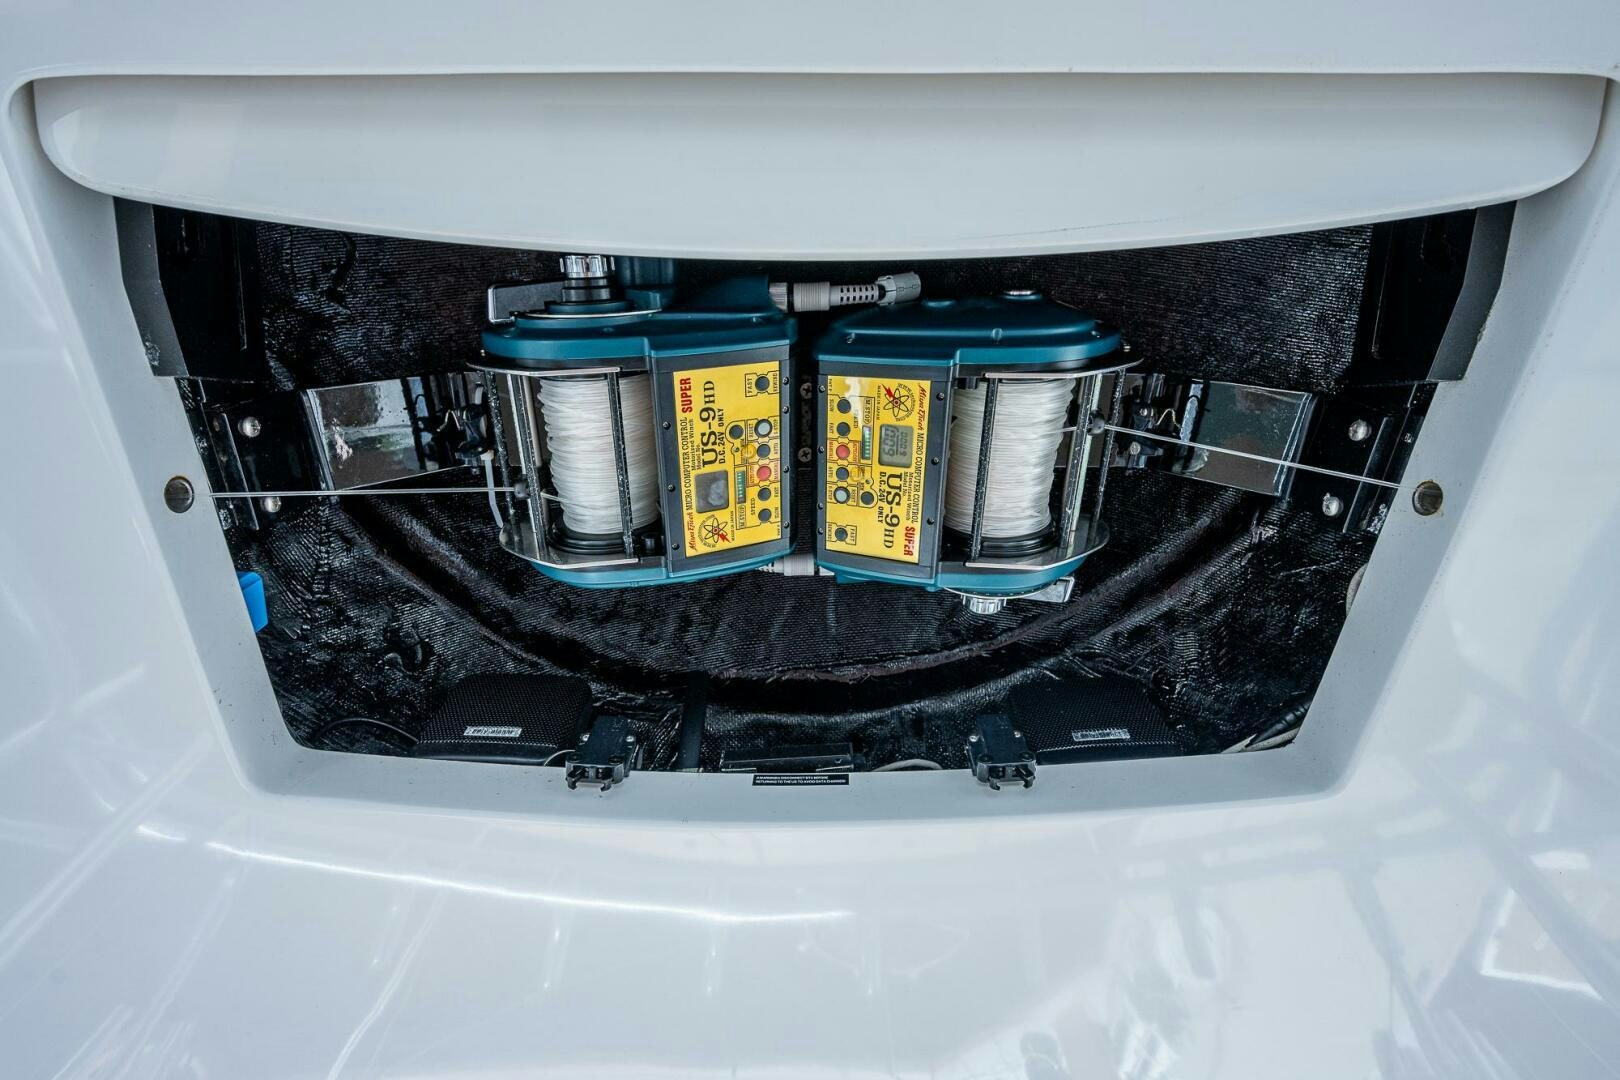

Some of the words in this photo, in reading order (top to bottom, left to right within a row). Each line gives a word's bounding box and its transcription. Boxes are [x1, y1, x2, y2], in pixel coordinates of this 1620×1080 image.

[679, 378, 693, 413] SUPER
[680, 417, 689, 450] CONTROL
[916, 432, 924, 455] MICRO
[682, 451, 692, 488] COMPUTER
[914, 457, 922, 492] COMPUTER
[684, 489, 693, 511] MICRO
[912, 493, 920, 523] CONTROL
[904, 526, 916, 556] SUPER
